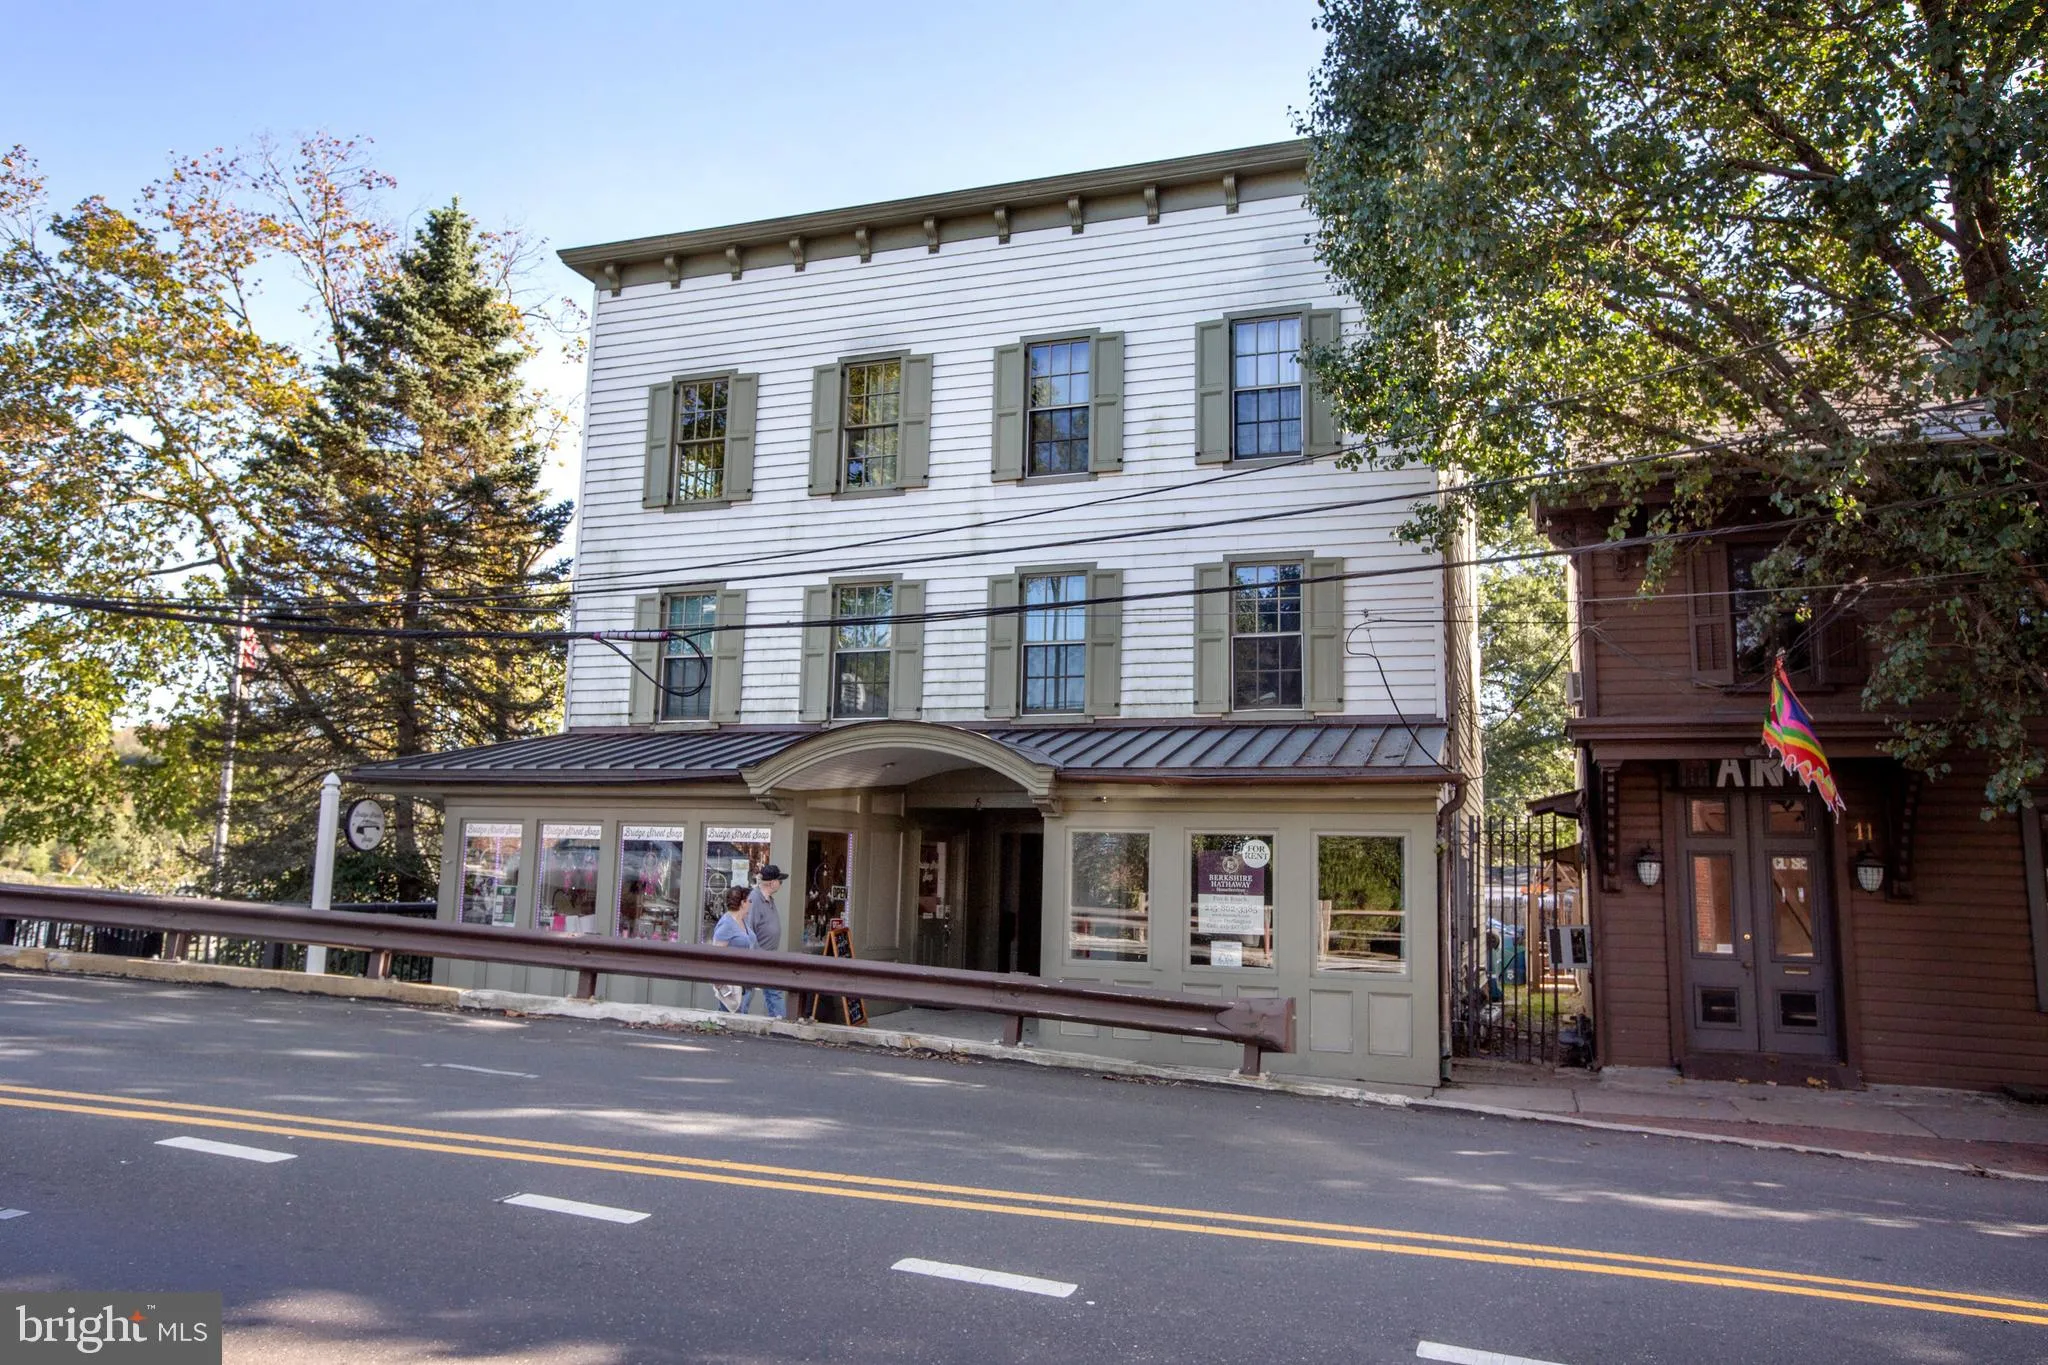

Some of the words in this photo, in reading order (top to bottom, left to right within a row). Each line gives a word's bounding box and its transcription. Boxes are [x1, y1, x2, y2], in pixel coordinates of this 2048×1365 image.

[1716, 759, 1805, 787] AR
[623, 826, 645, 839] Bridge
[645, 826, 666, 838] Street
[666, 827, 683, 839] Soap
[707, 828, 731, 841] Bridge
[730, 828, 752, 841] Street
[752, 829, 770, 841] Soap
[1854, 821, 1873, 841] 11
[1247, 844, 1265, 853] FOR
[1244, 852, 1269, 861] RENT
[1209, 874, 1253, 882] BERKSHIRE
[832, 887, 848, 899] OPEN
